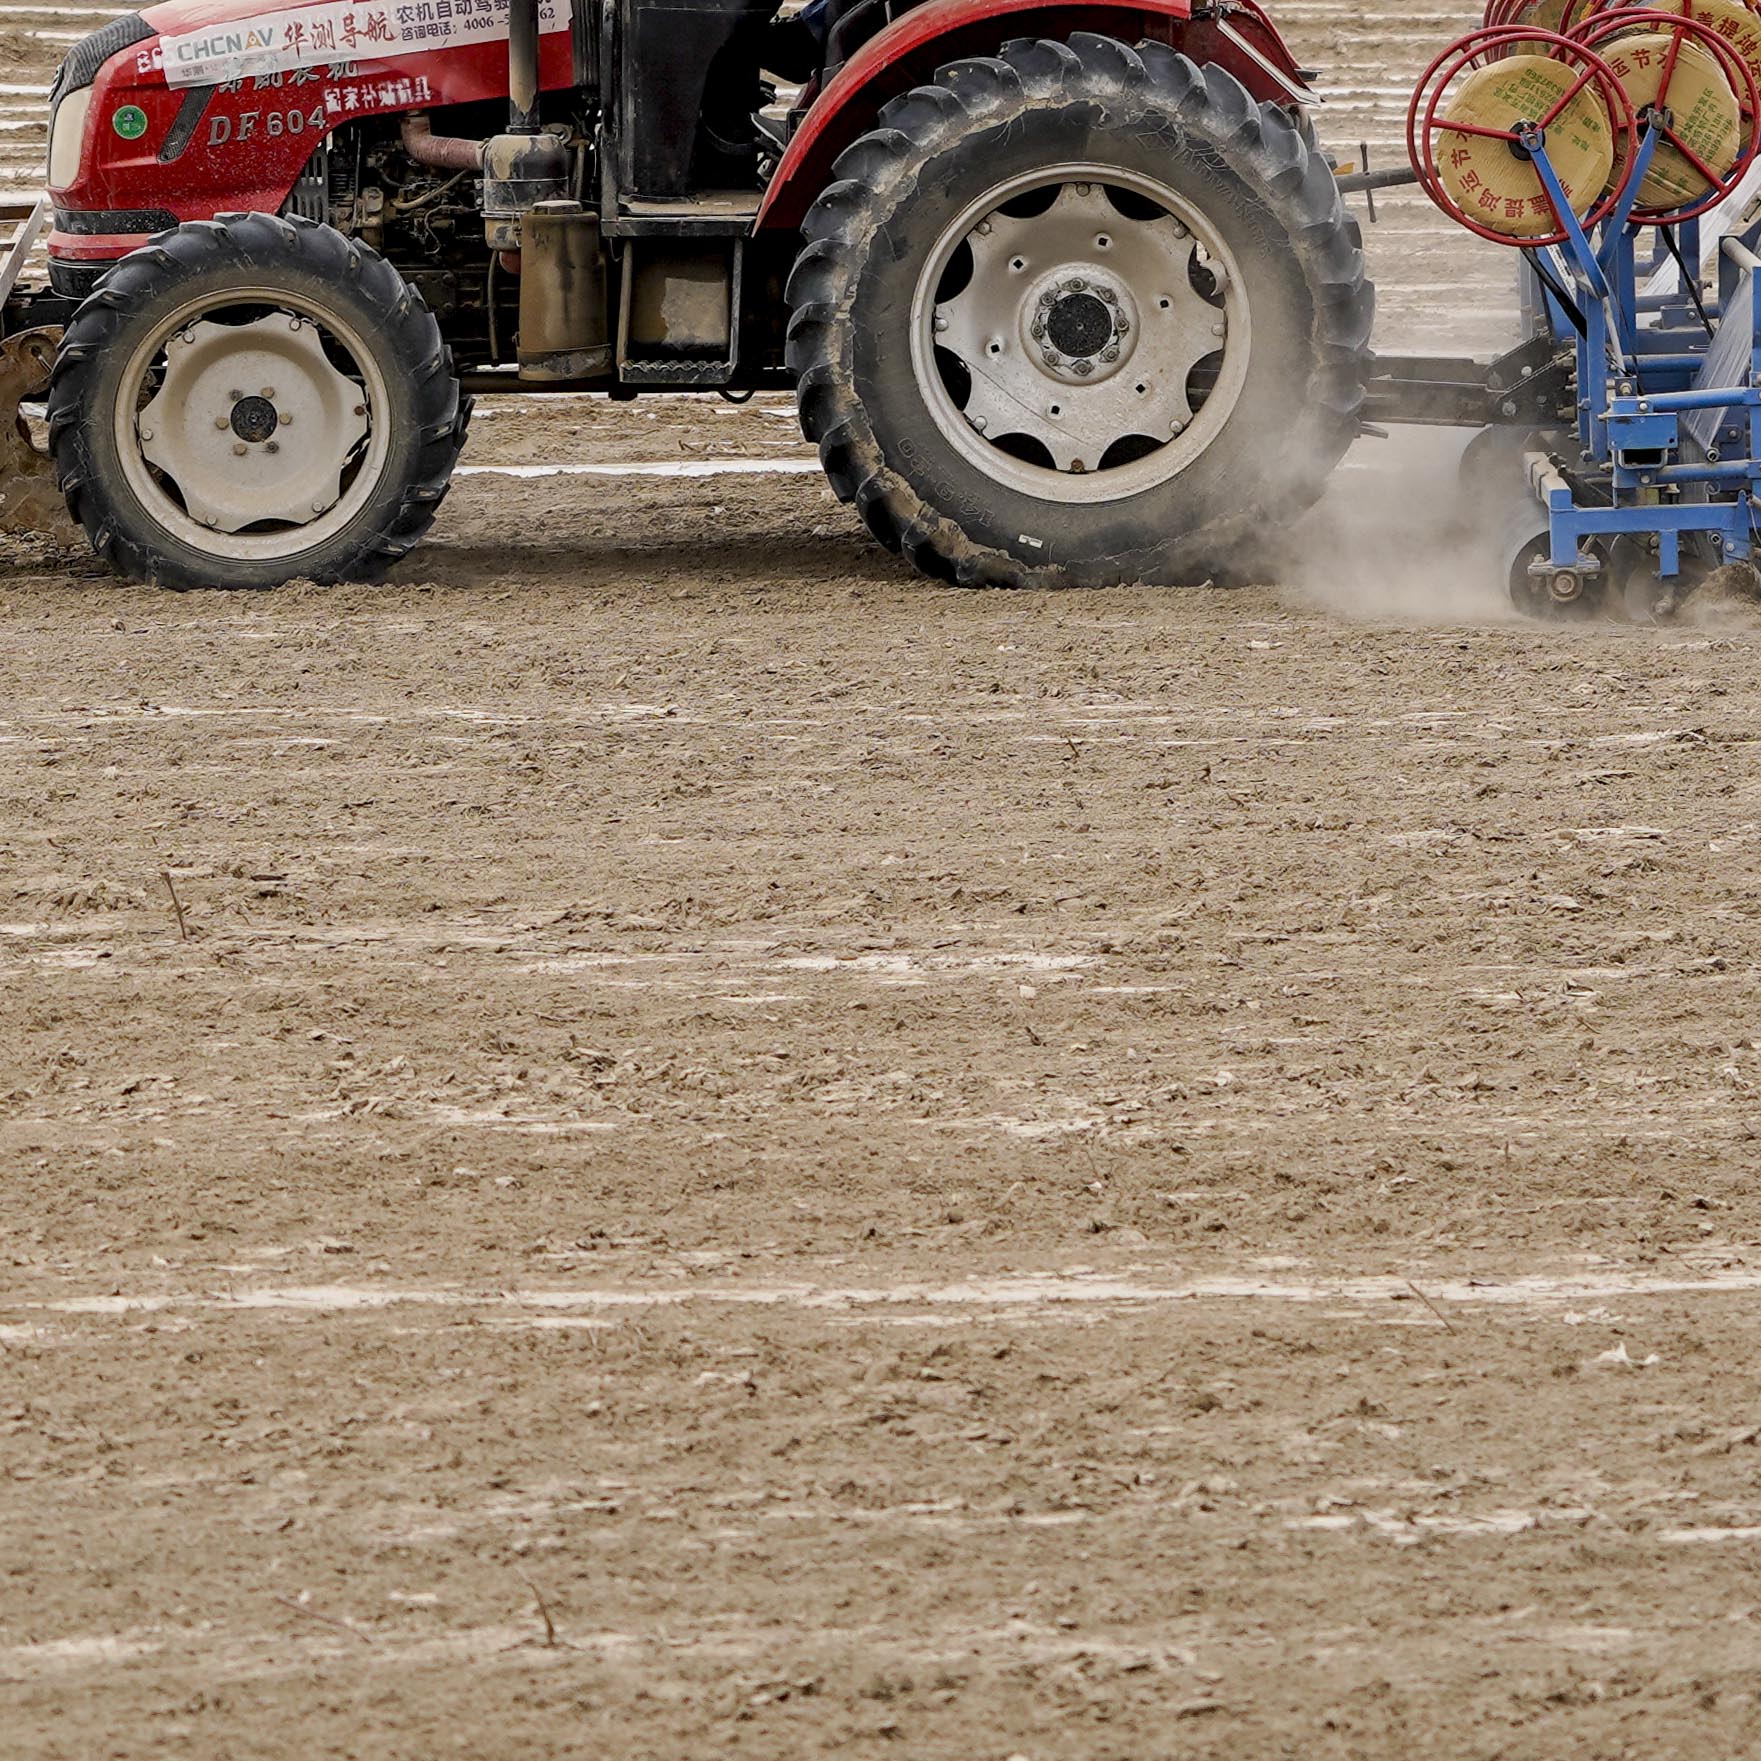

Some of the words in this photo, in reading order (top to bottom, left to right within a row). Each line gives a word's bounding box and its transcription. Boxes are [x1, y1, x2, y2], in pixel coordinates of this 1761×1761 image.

[177, 28, 273, 61] CHCNAV
[282, 11, 396, 58] 华测导航
